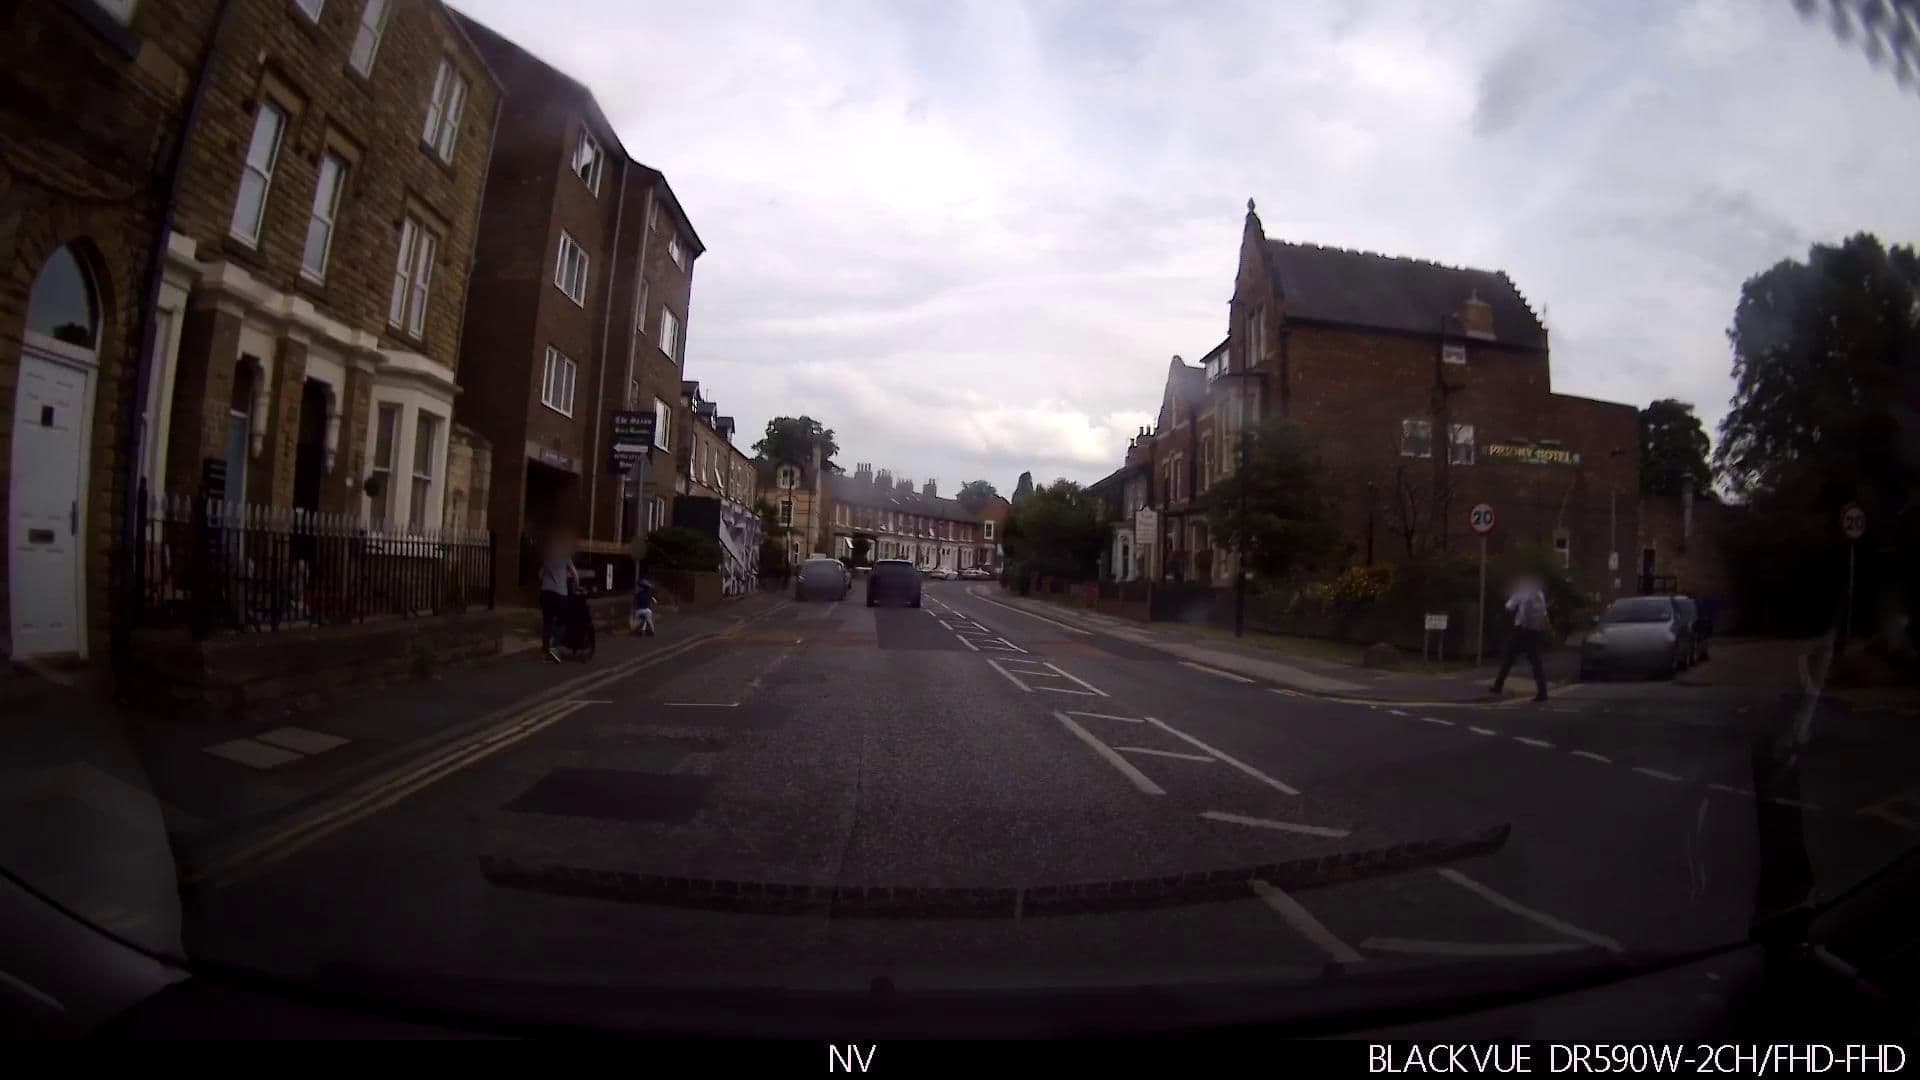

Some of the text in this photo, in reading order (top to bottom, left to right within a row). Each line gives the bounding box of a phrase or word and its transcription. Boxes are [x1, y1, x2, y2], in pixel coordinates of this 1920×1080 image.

[1534, 448, 1571, 463] HOTEL
[1472, 510, 1493, 526] 20
[1846, 515, 1865, 531] 20
